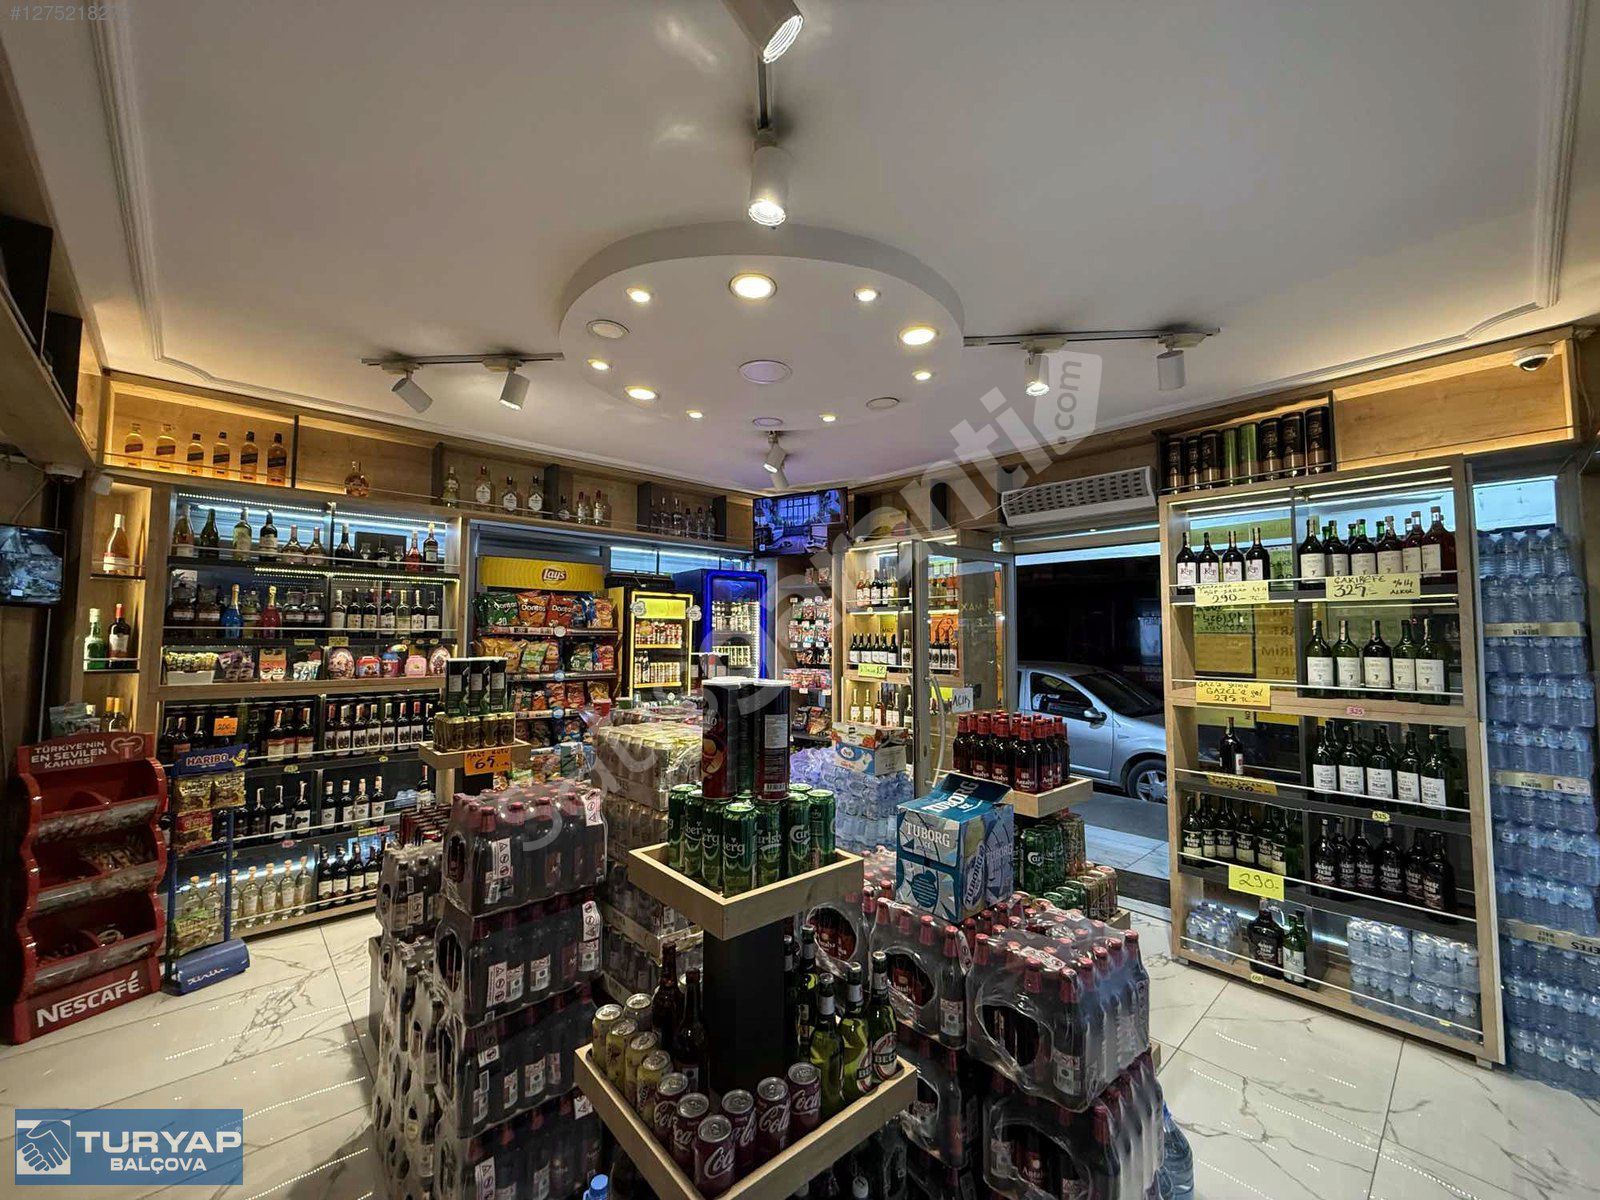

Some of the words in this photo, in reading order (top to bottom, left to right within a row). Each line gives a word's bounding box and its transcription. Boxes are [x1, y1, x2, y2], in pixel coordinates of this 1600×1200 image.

[31, 754, 50, 764] EN
[53, 747, 107, 761] SEVİLEN
[44, 756, 94, 769] KAHVESİ
[186, 753, 229, 766] HARIBO
[904, 822, 951, 848] TUBORG
[964, 843, 988, 905] TUBORG
[36, 970, 142, 1028] NESCAFÉ
